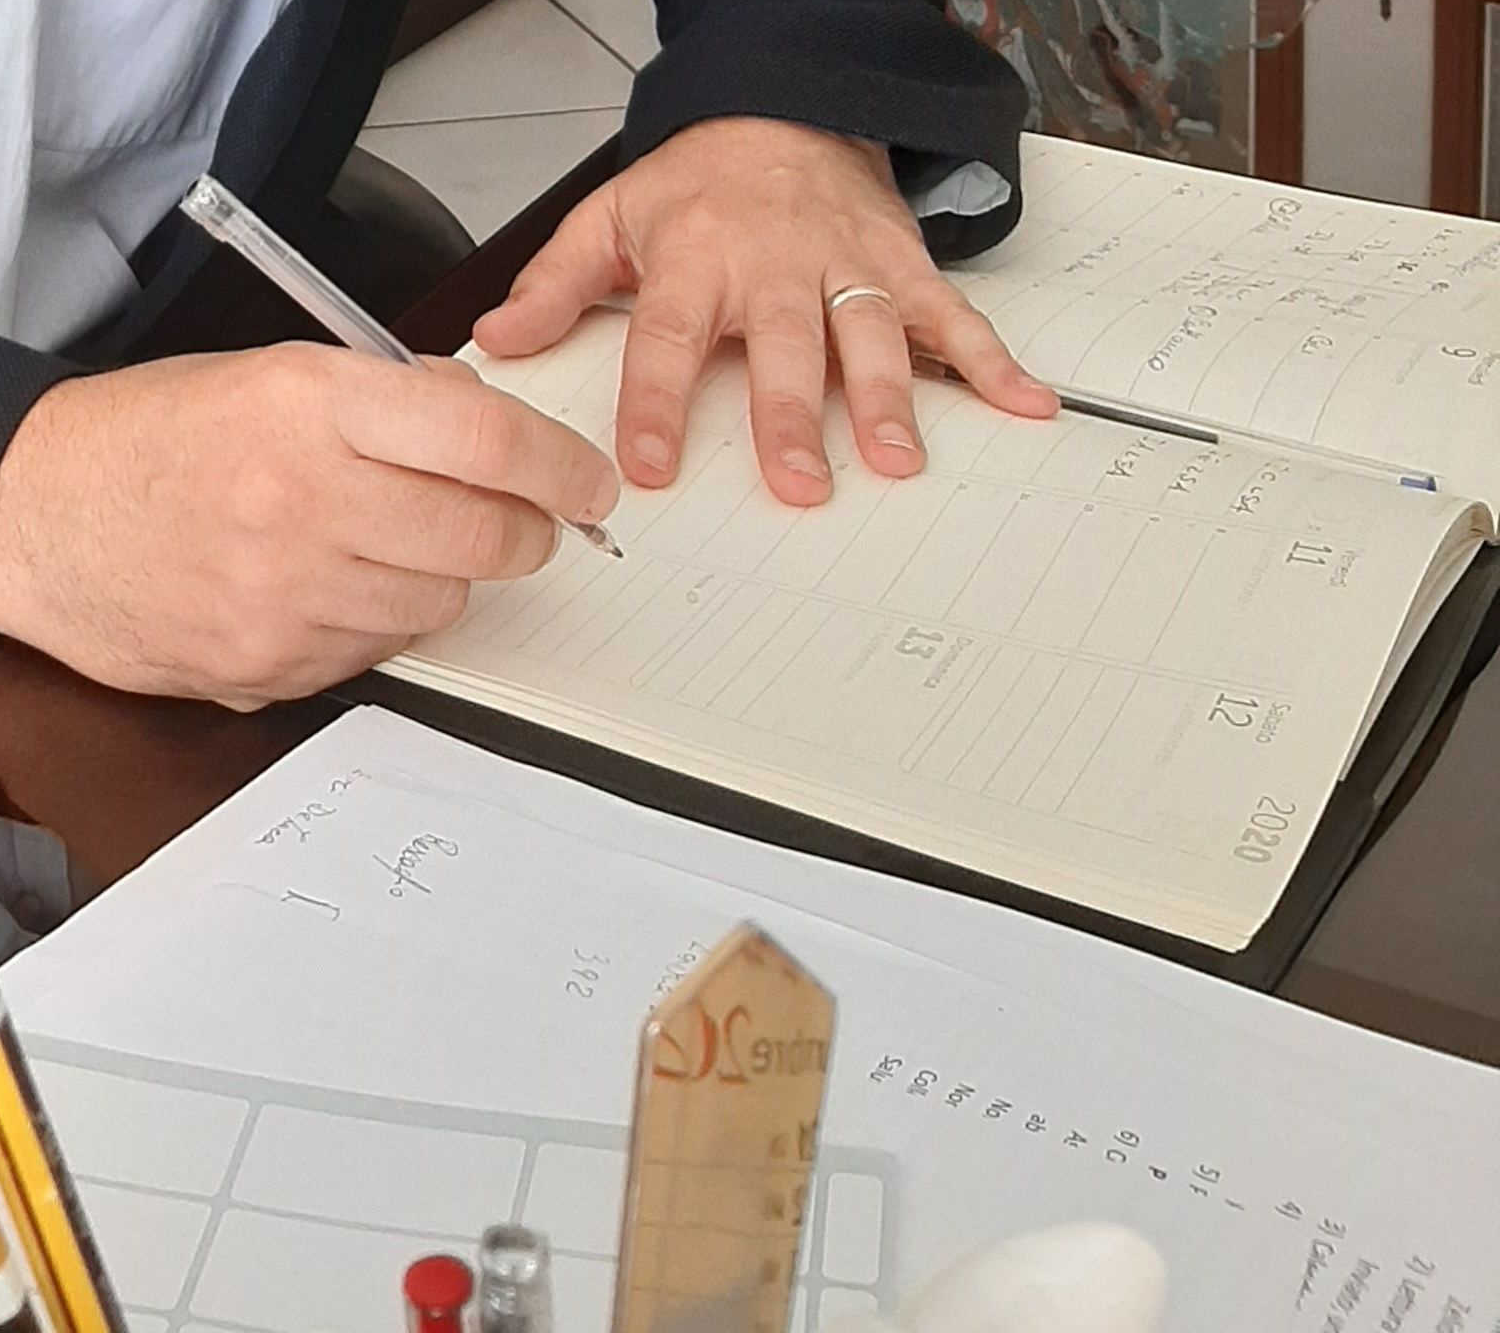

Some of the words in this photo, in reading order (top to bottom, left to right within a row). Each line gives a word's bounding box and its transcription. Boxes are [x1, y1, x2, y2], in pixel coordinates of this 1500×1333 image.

[1285, 540, 1333, 564] 11
[894, 626, 944, 659] 13
[1208, 693, 1260, 728] 12
[1256, 701, 1292, 744] Sabato
[1233, 796, 1297, 863] 2020
[1114, 1130, 1140, 1148] 6)
[1192, 1164, 1220, 1184] 5)
